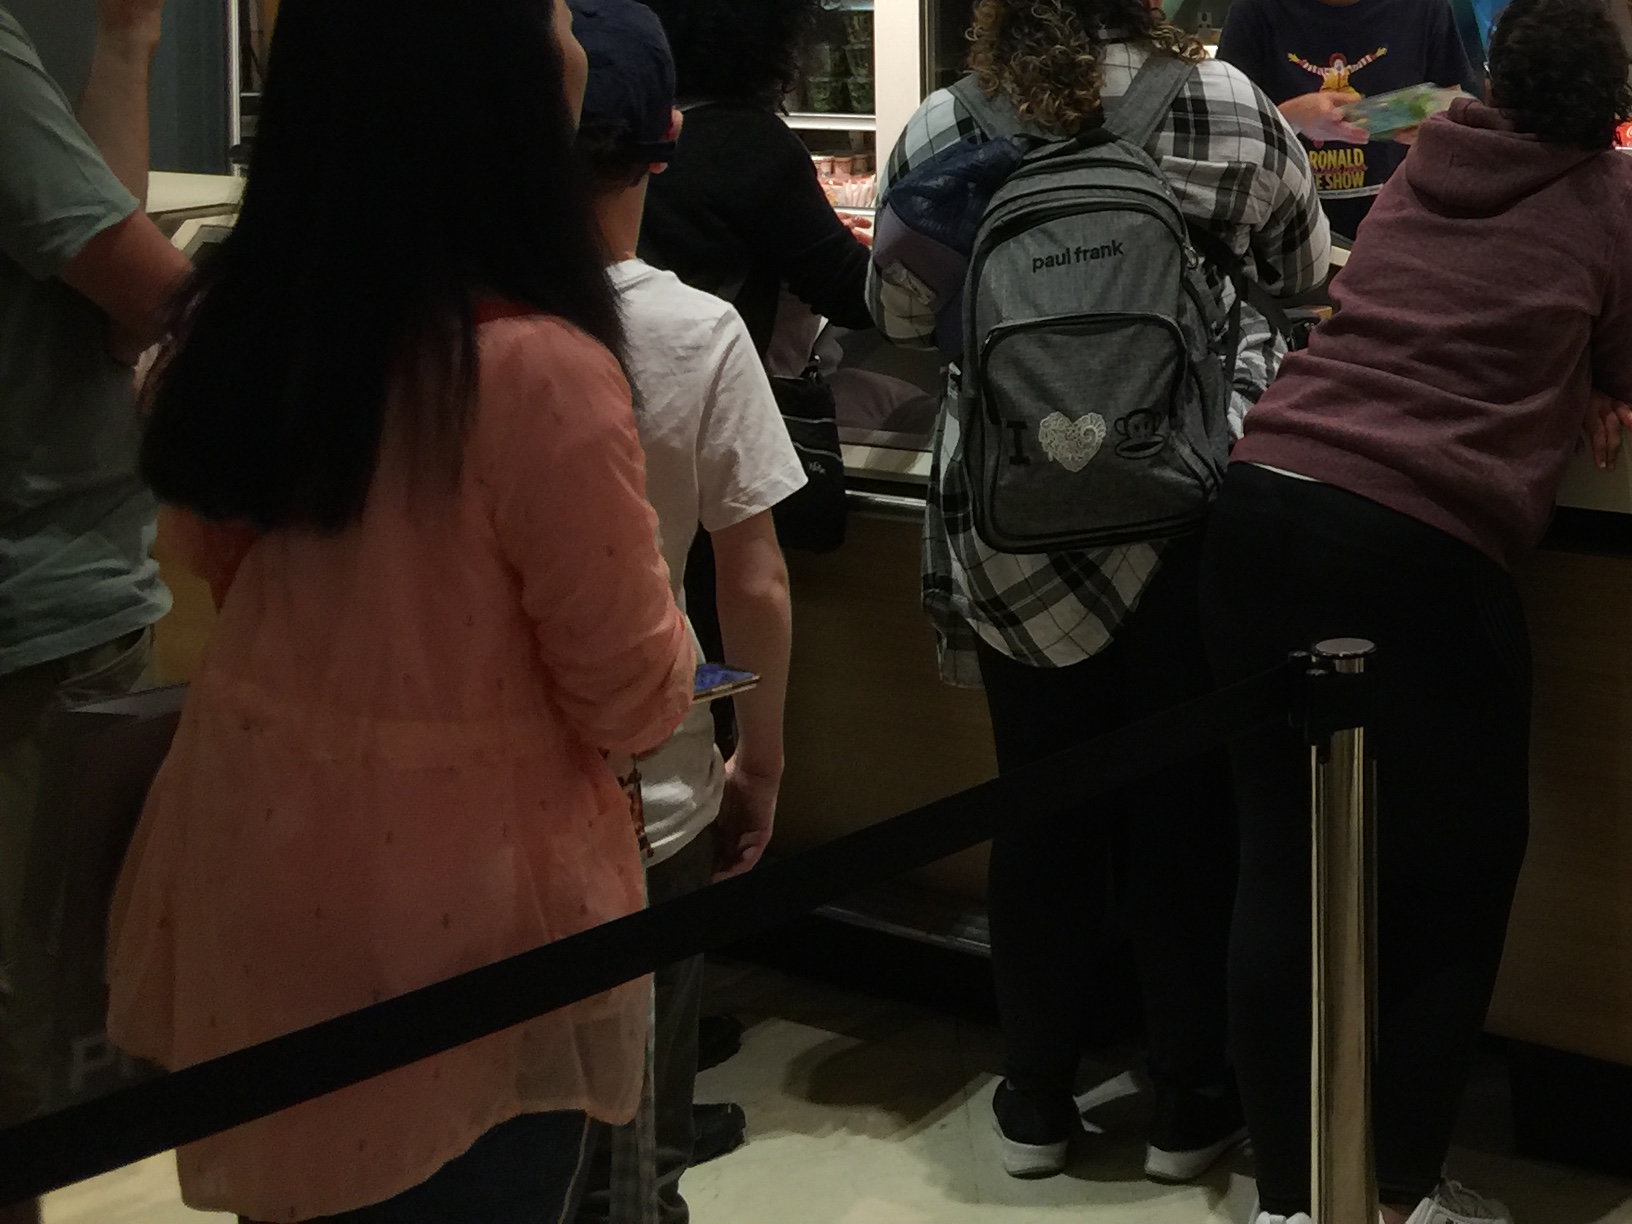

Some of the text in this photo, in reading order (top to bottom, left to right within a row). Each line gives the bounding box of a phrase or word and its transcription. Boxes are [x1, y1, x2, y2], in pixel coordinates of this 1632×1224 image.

[1309, 148, 1365, 169] RONALD
[1325, 170, 1365, 190] SHOW
[1032, 239, 1124, 274] paul frank
